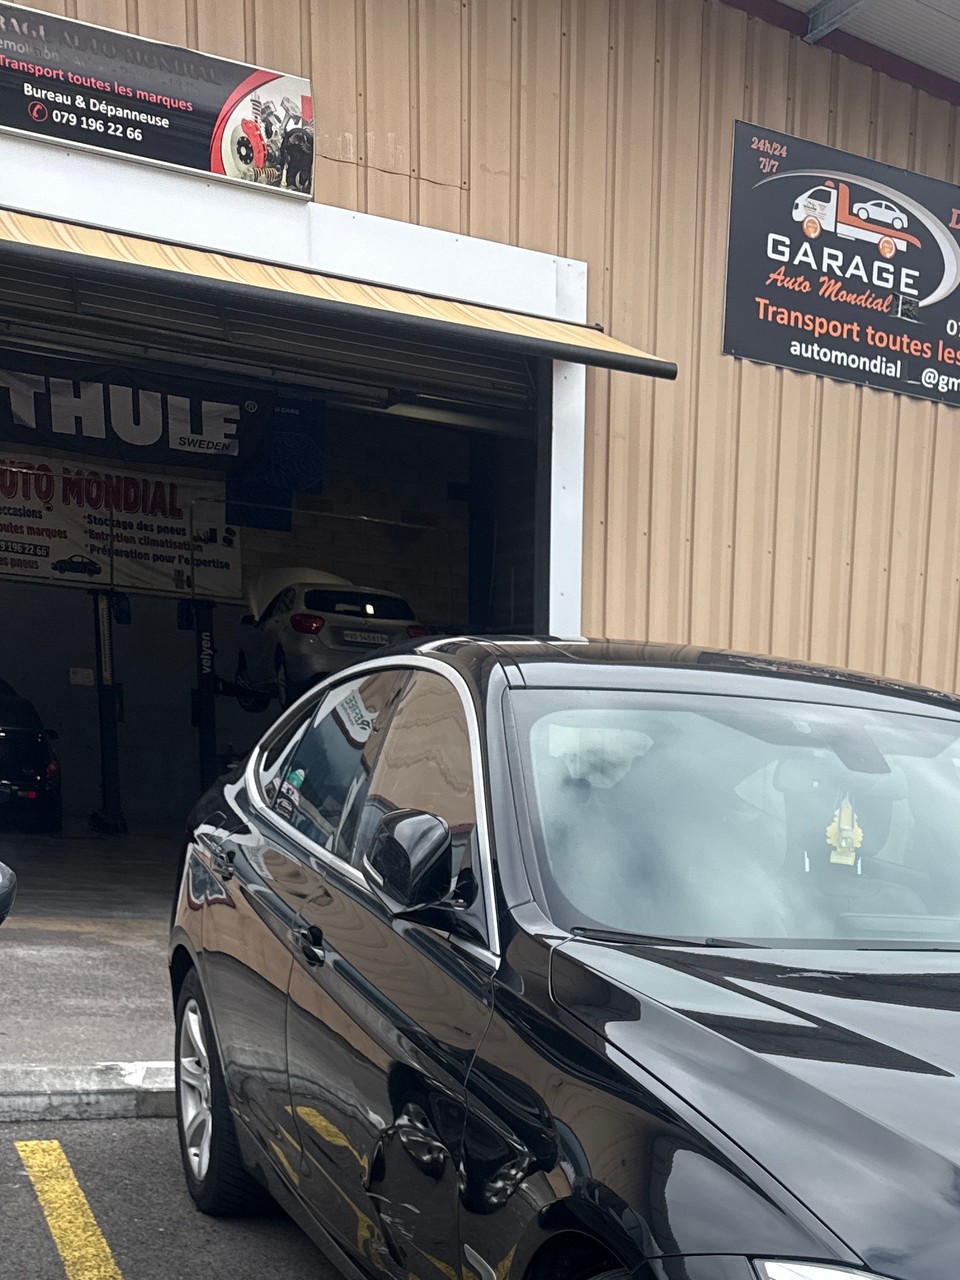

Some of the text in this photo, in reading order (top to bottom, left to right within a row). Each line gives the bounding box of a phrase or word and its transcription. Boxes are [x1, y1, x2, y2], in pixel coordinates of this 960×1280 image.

[0, 54, 64, 81] Transport
[68, 71, 111, 92] toutes
[114, 81, 132, 97] les
[136, 89, 193, 112] marques
[23, 82, 169, 128] Bureau & Dépanneuse
[52, 109, 142, 141] 079 196 22 66
[750, 136, 787, 157] 24h/24
[759, 157, 779, 173] 7j/7
[767, 233, 919, 296] GARAGE
[765, 265, 893, 313] Auto Mondial
[755, 297, 861, 342] Transport
[865, 326, 932, 359] toutes
[790, 340, 901, 379] automondial
[0, 370, 240, 456] THULE
[179, 437, 231, 451] SWEDEN
[62, 467, 183, 518] MONDIAL
[0, 505, 42, 519] ccasions
[26, 526, 67, 540] marques
[136, 521, 154, 532] des
[157, 525, 187, 537] pneus
[7, 543, 23, 553] 196
[25, 545, 34, 555] 22
[36, 546, 46, 556] 66
[11, 558, 39, 570] pneus
[152, 550, 175, 563] pour
[200, 632, 214, 673] velyen
